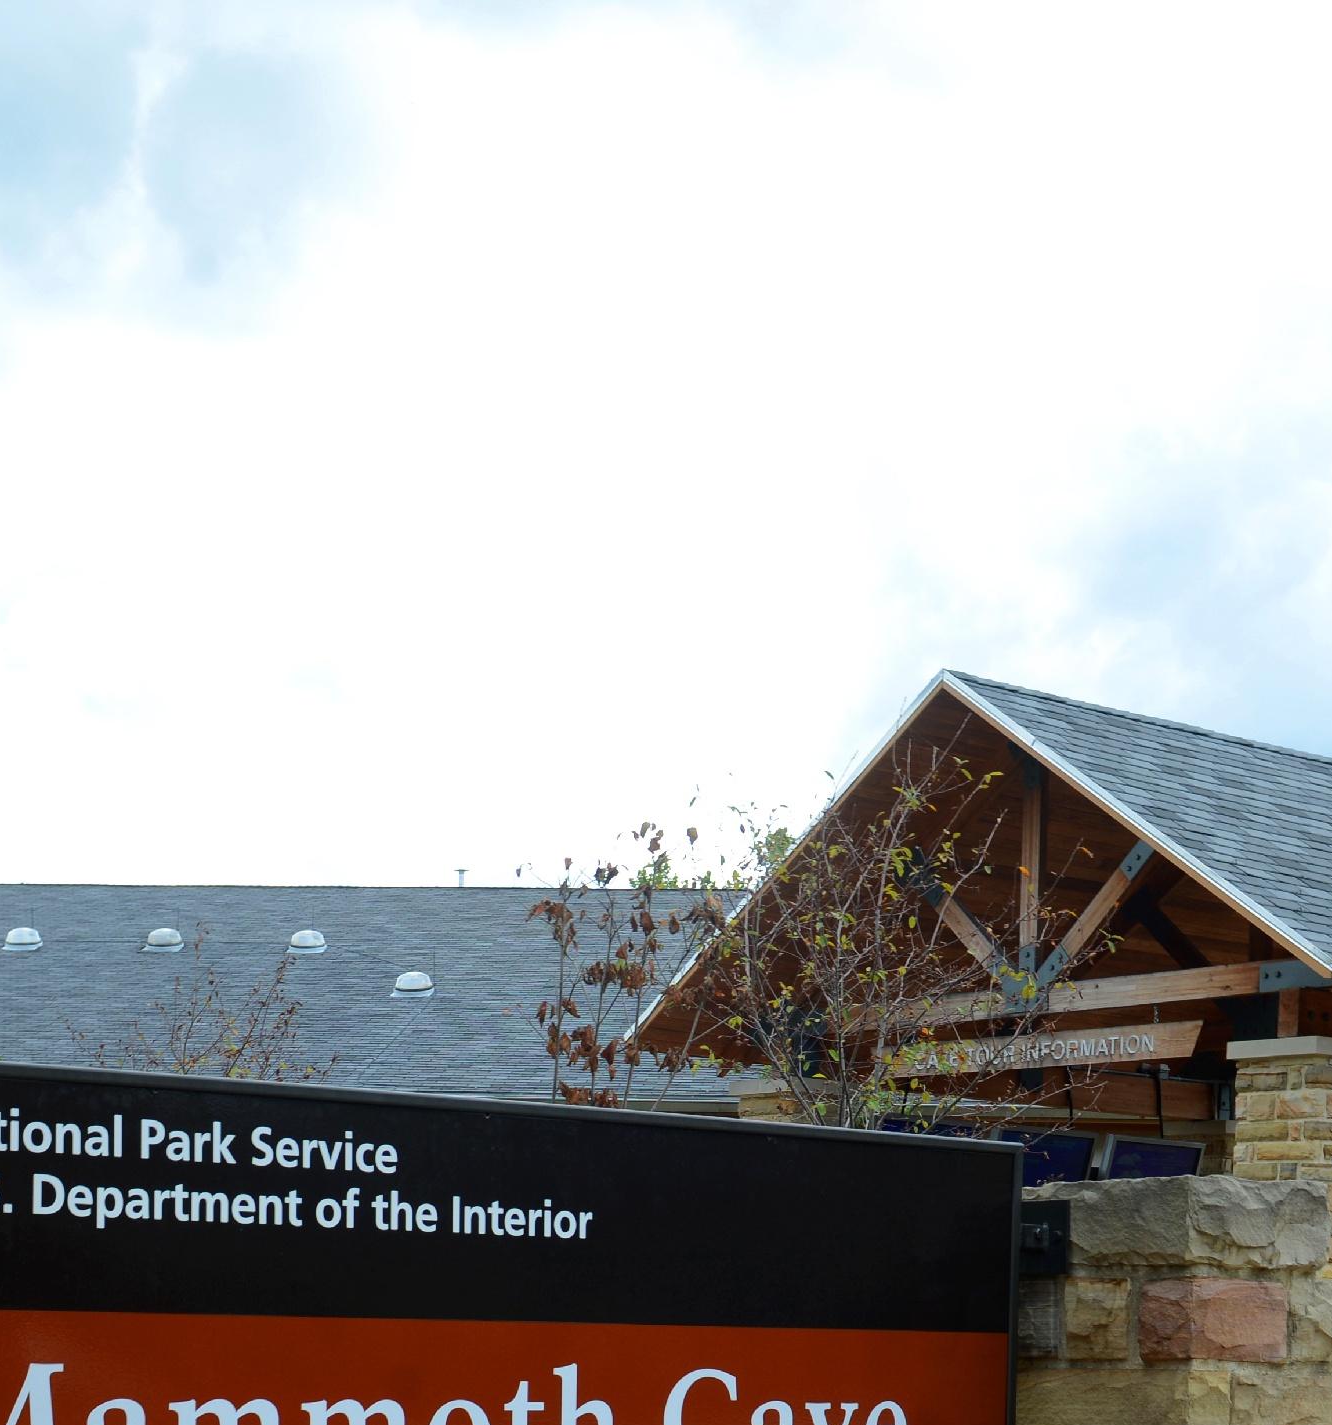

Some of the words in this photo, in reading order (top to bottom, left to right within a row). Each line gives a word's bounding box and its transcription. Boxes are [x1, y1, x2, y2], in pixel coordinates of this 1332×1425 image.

[965, 1044, 1016, 1066] TOUR
[1020, 1034, 1154, 1063] INFORMATION
[140, 1118, 237, 1165] Park
[250, 1126, 398, 1174] Service
[32, 1173, 303, 1229] Department
[315, 1187, 361, 1229] of
[370, 1190, 438, 1233] the
[452, 1195, 593, 1240] Interior
